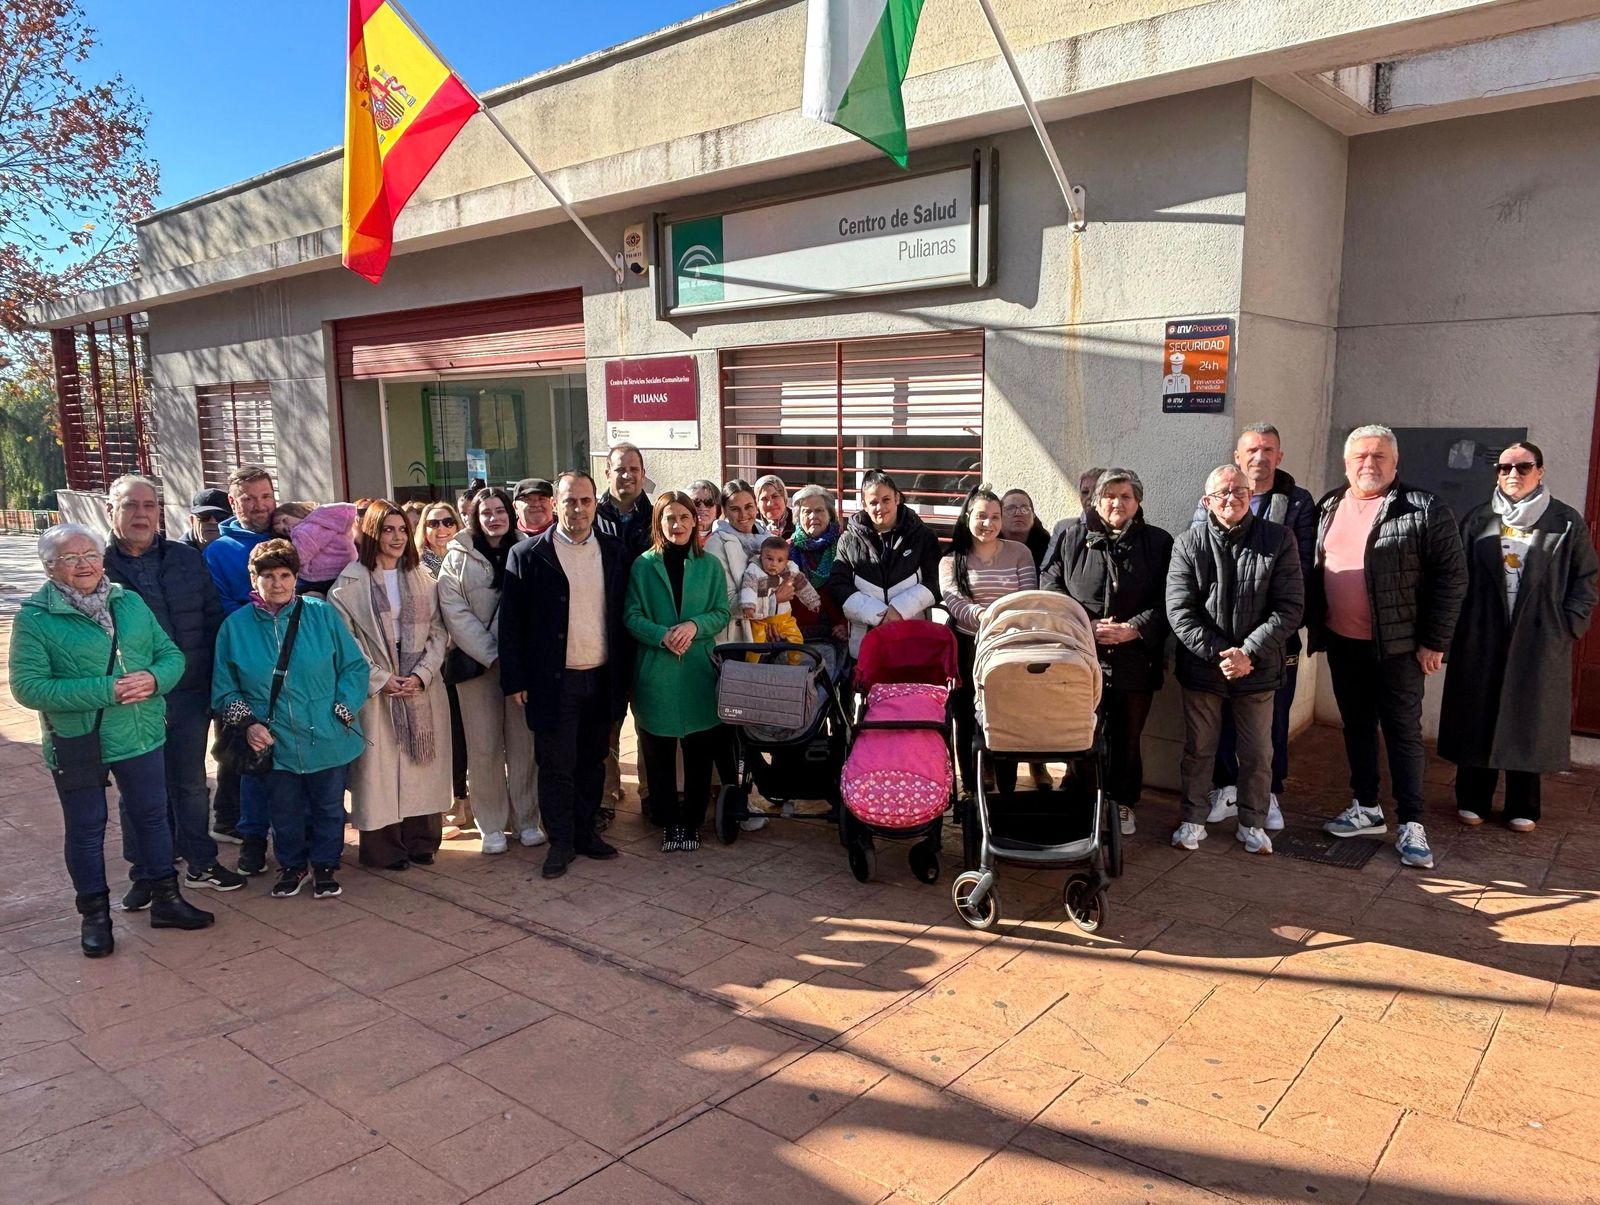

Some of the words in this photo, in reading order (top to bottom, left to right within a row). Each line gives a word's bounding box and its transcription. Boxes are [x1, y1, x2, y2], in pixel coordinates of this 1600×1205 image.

[838, 216, 887, 236] Centro
[890, 208, 909, 229] de
[913, 198, 957, 225] Salud
[898, 238, 956, 261] Pulianas
[1169, 340, 1225, 352] SEGURIDAD
[1199, 361, 1219, 371] 24h
[629, 377, 646, 385] Servicios
[633, 393, 668, 404] PULIANAS
